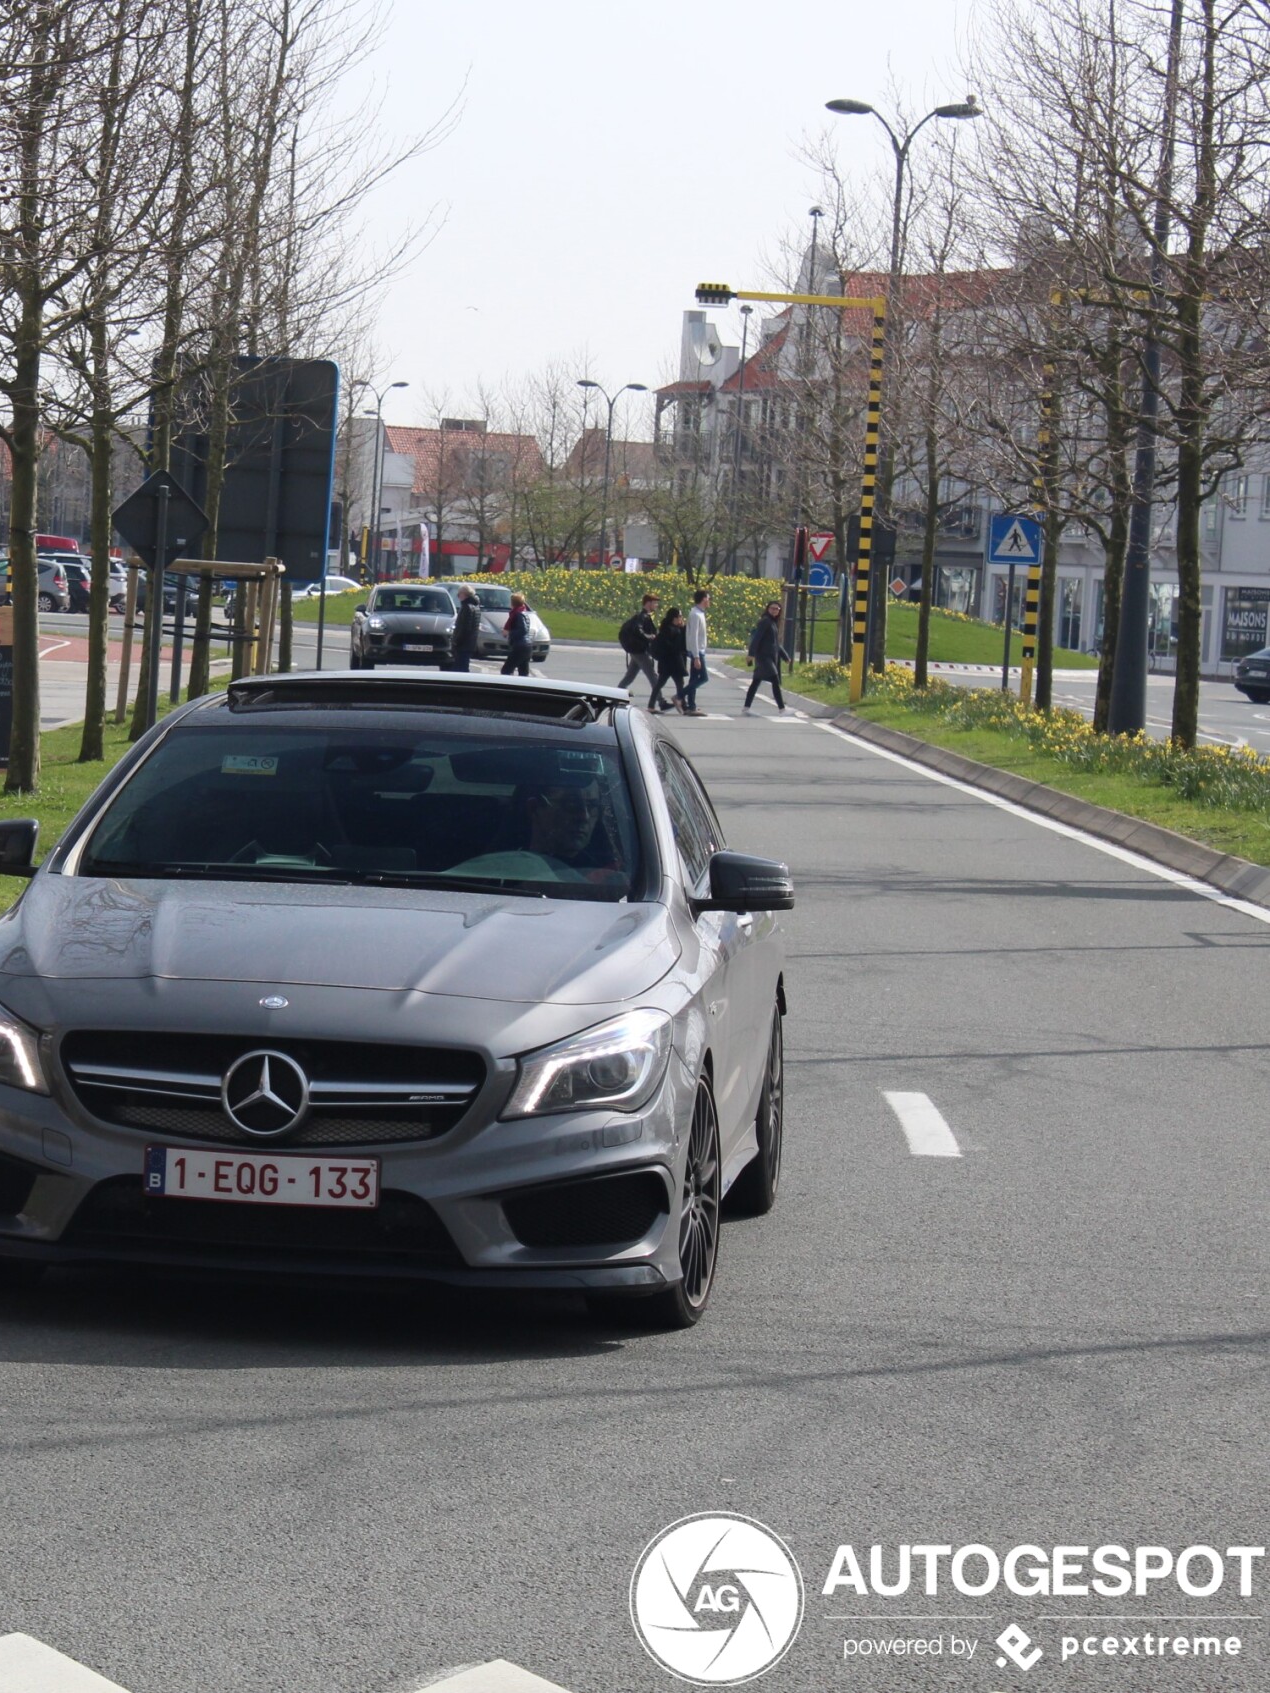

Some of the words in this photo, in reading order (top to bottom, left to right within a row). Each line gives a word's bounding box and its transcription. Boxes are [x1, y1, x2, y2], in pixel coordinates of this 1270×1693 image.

[1227, 610, 1266, 628] MAISONS
[149, 1172, 161, 1188] B
[174, 1157, 371, 1200] 1-EQG-133
